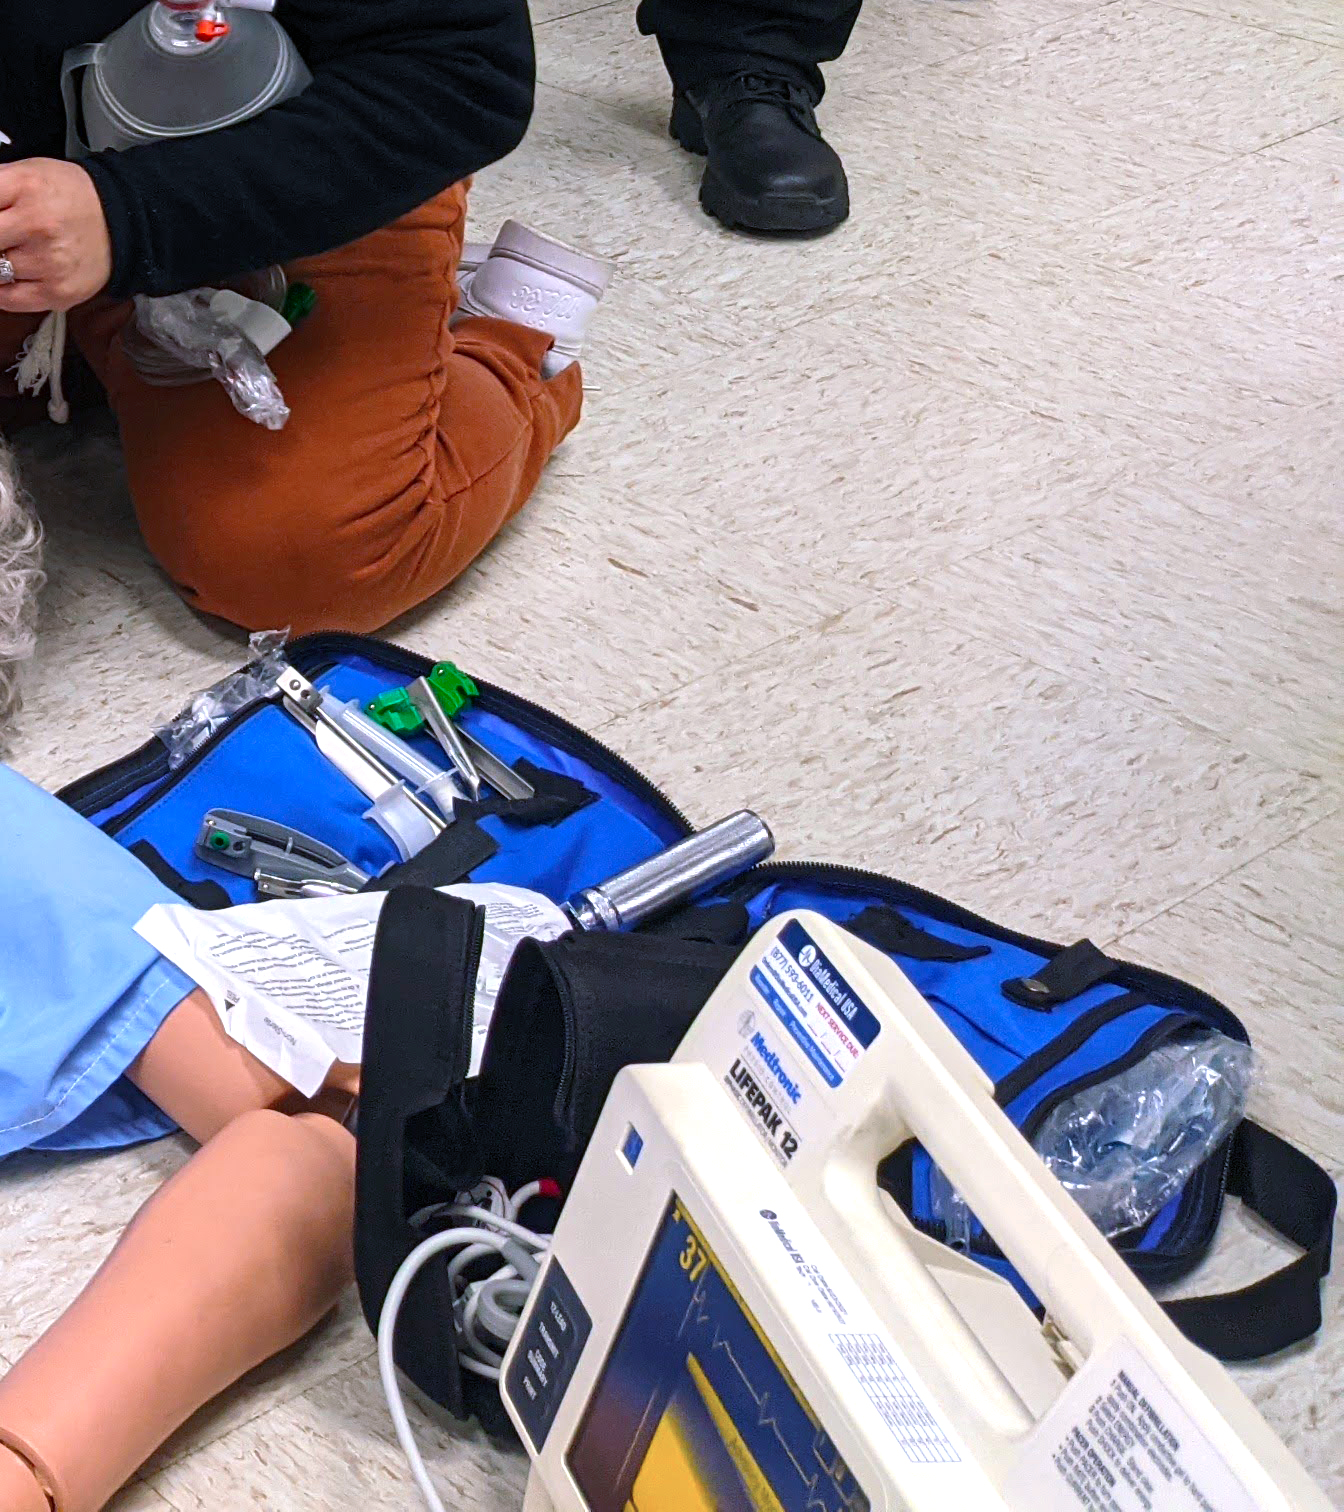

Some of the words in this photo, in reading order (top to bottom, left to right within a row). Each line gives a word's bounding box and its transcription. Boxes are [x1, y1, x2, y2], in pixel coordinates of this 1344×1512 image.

[771, 946, 787, 969] (877)
[809, 959, 847, 1005] DiaMedical
[840, 998, 857, 1020] USA
[816, 1003, 829, 1020] NEXT
[828, 1018, 847, 1044] SERVICE
[750, 1032, 801, 1104] Medtronic
[730, 1059, 782, 1136] LIFEPAK
[779, 1130, 799, 1159] 12
[679, 1234, 709, 1282] 37
